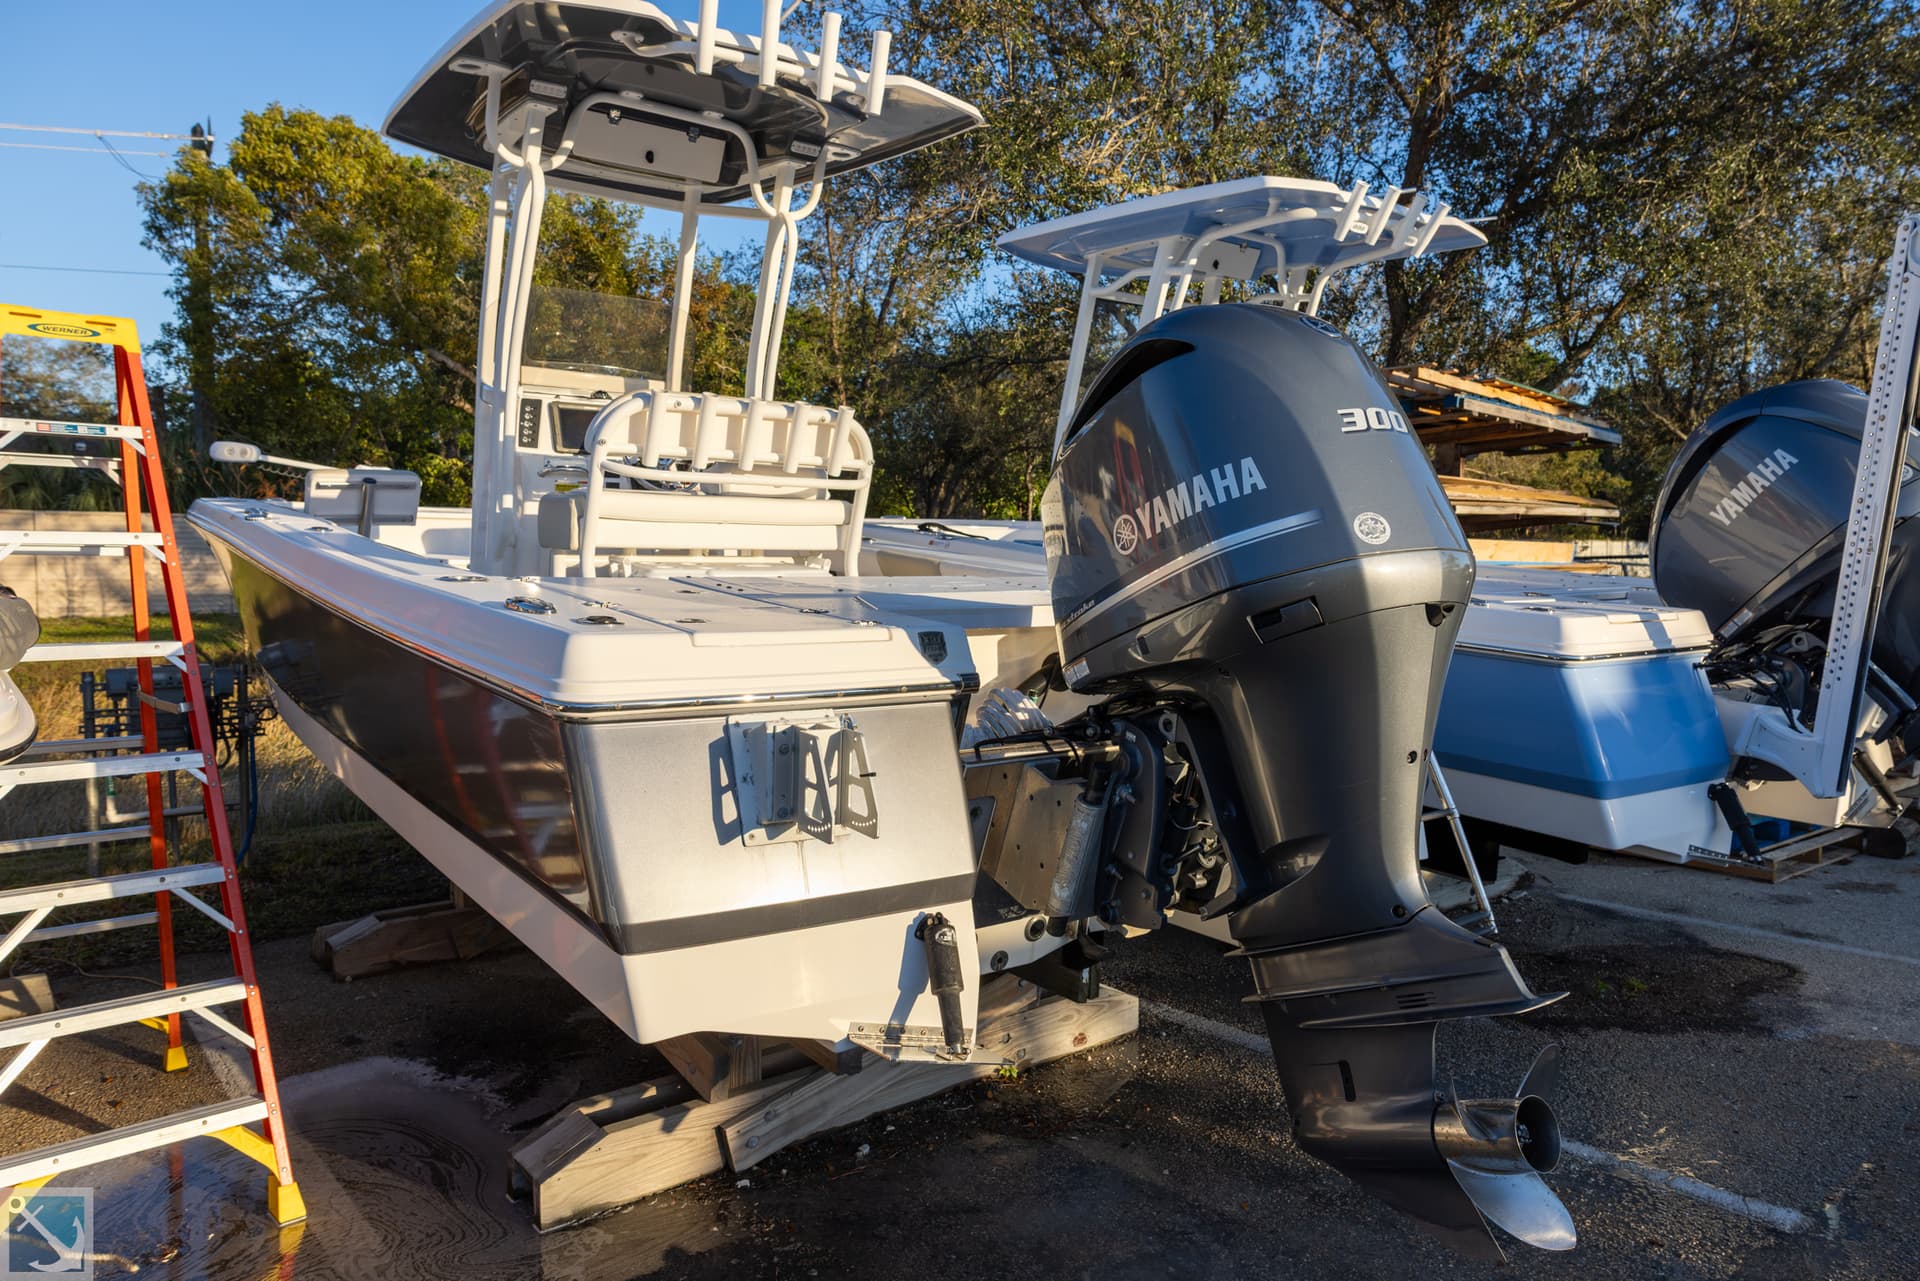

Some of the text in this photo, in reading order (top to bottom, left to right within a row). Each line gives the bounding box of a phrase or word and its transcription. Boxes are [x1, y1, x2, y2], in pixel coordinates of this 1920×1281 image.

[42, 325, 88, 335] WERNER
[1336, 407, 1409, 434] 300
[1135, 456, 1267, 540] YAMAHA
[1710, 448, 1798, 525] YAMAHA
